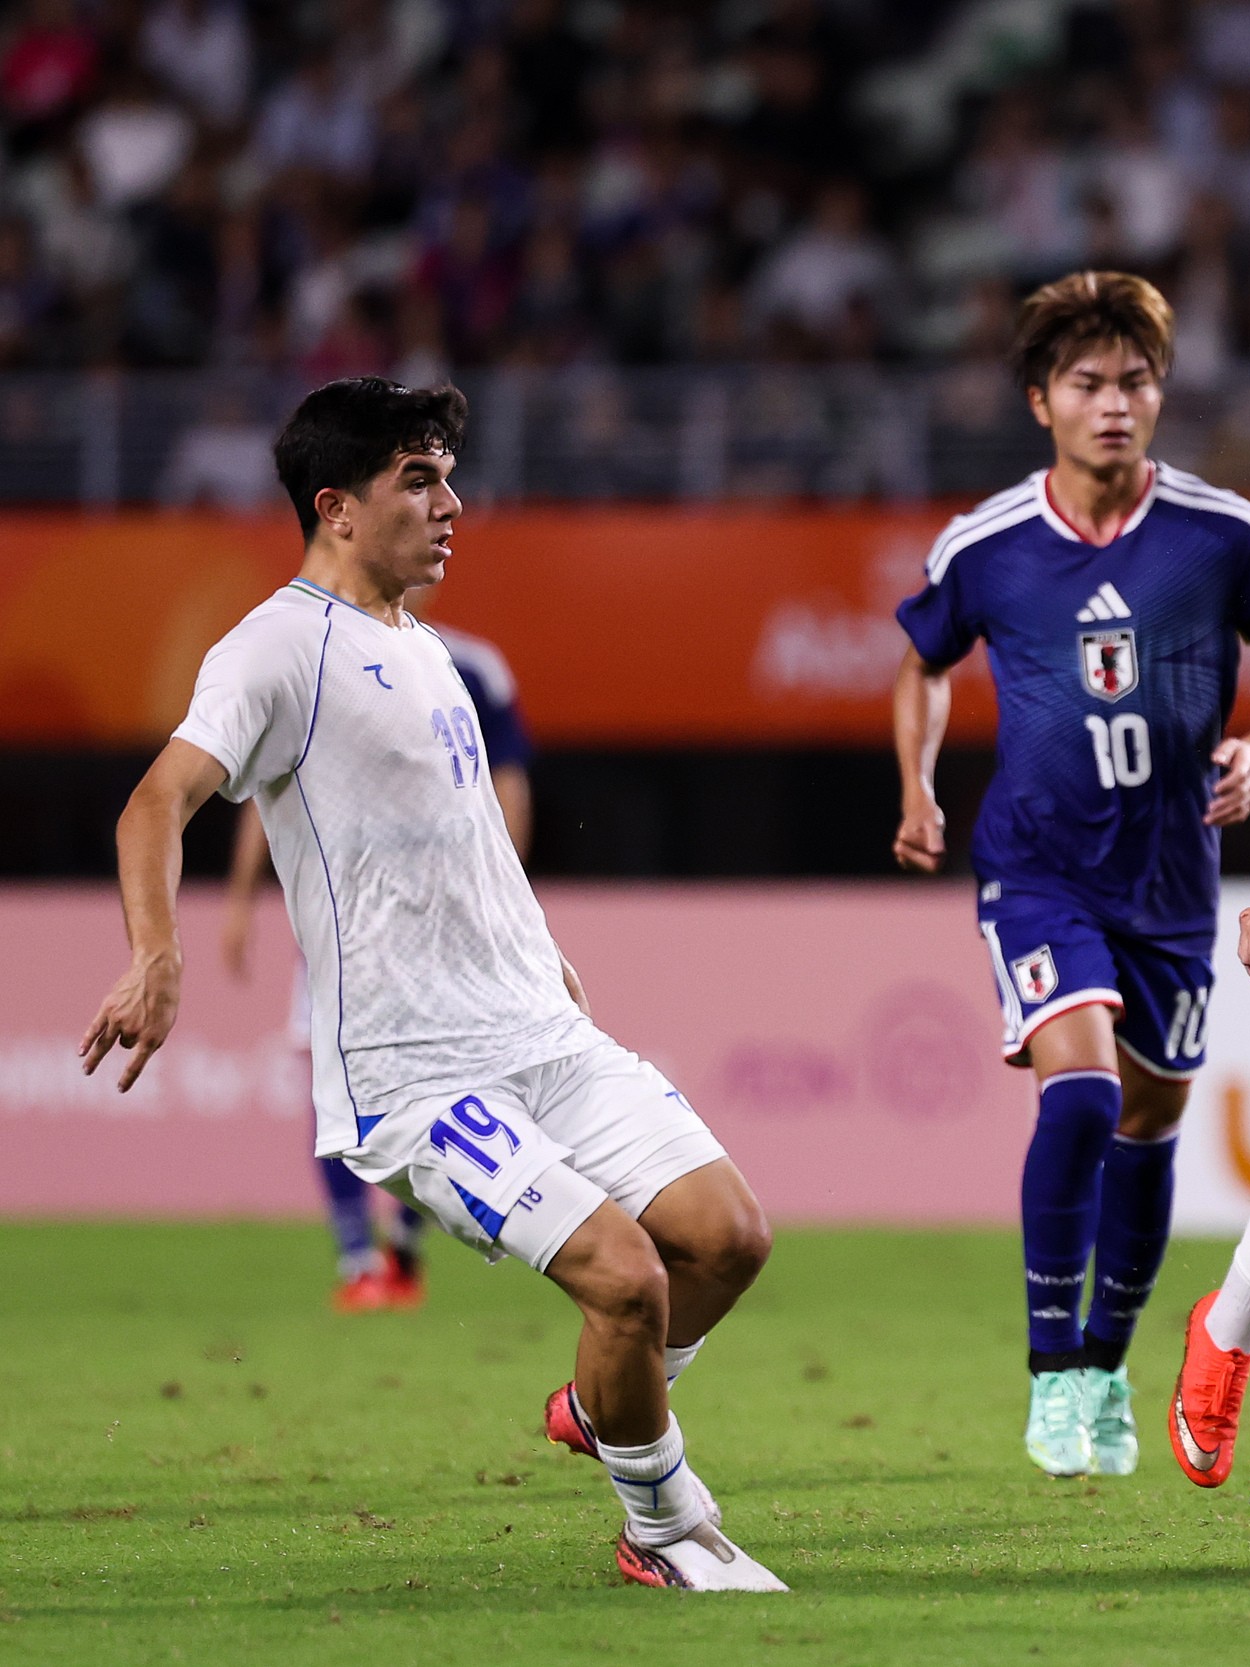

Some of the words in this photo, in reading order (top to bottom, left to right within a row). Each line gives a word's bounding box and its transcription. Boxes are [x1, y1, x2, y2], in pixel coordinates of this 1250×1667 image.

[431, 706, 479, 788] 19
[1084, 713, 1152, 789] 10
[1164, 986, 1208, 1061] 10
[430, 1094, 523, 1180] 19
